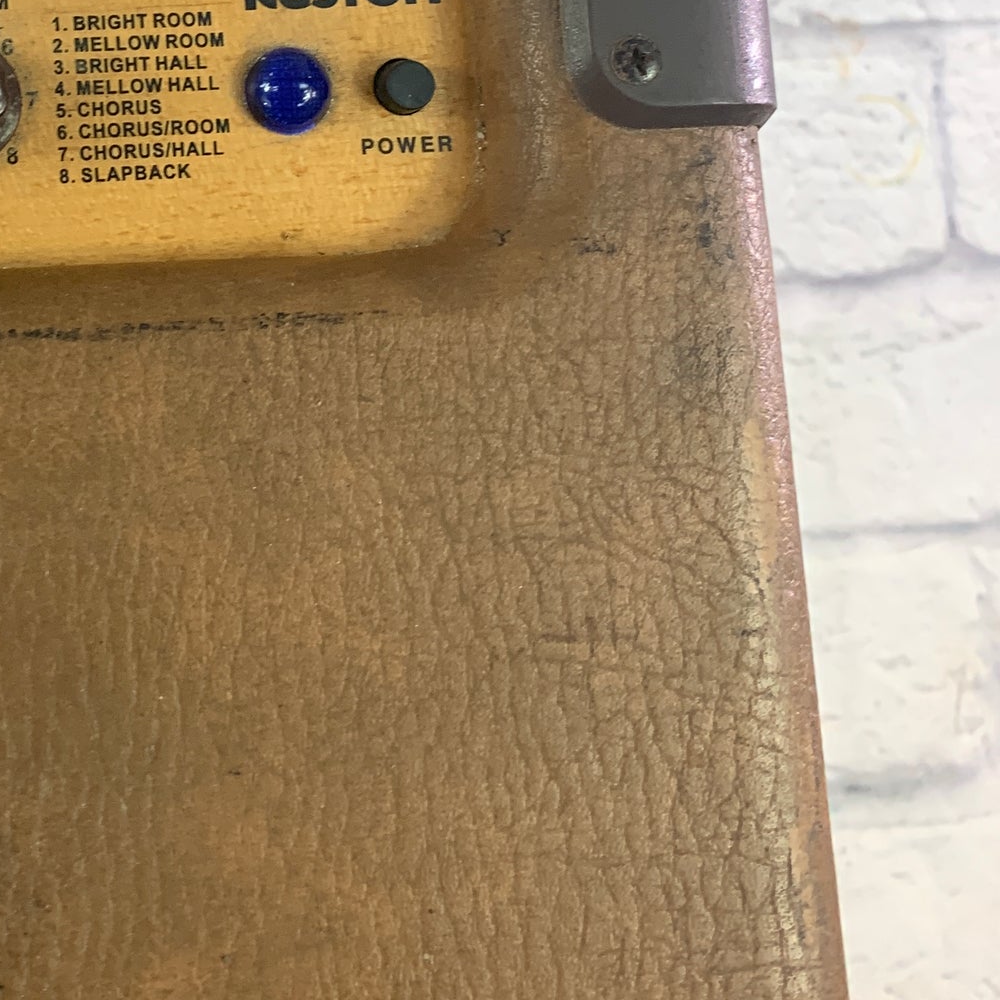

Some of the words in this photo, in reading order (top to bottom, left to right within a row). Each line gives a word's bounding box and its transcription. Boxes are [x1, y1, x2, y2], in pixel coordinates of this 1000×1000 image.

[52, 16, 68, 31] 1.
[72, 13, 147, 31] BRIGHT
[153, 11, 212, 28] ROOM
[1, 38, 14, 56] 6
[52, 38, 69, 53] 2.
[74, 34, 160, 52] MELLOW
[165, 32, 224, 49] ROOM
[53, 60, 70, 75] 3.
[75, 56, 150, 74] BRIGHT
[155, 54, 208, 71] HALL
[54, 81, 71, 96] 4.
[76, 77, 163, 95] MELLOW
[168, 76, 220, 92] HALL
[56, 103, 72, 118] 5.
[77, 99, 162, 117] CHORUS
[57, 125, 73, 140] 6.
[78, 118, 230, 139] CHORUS/ROOM
[6, 146, 19, 164] 8
[58, 147, 74, 162] 7.
[80, 141, 225, 161] CHORUS/HALL
[361, 134, 453, 155] POWER
[59, 168, 75, 184] 8.
[81, 163, 191, 183] SLAPBACK
